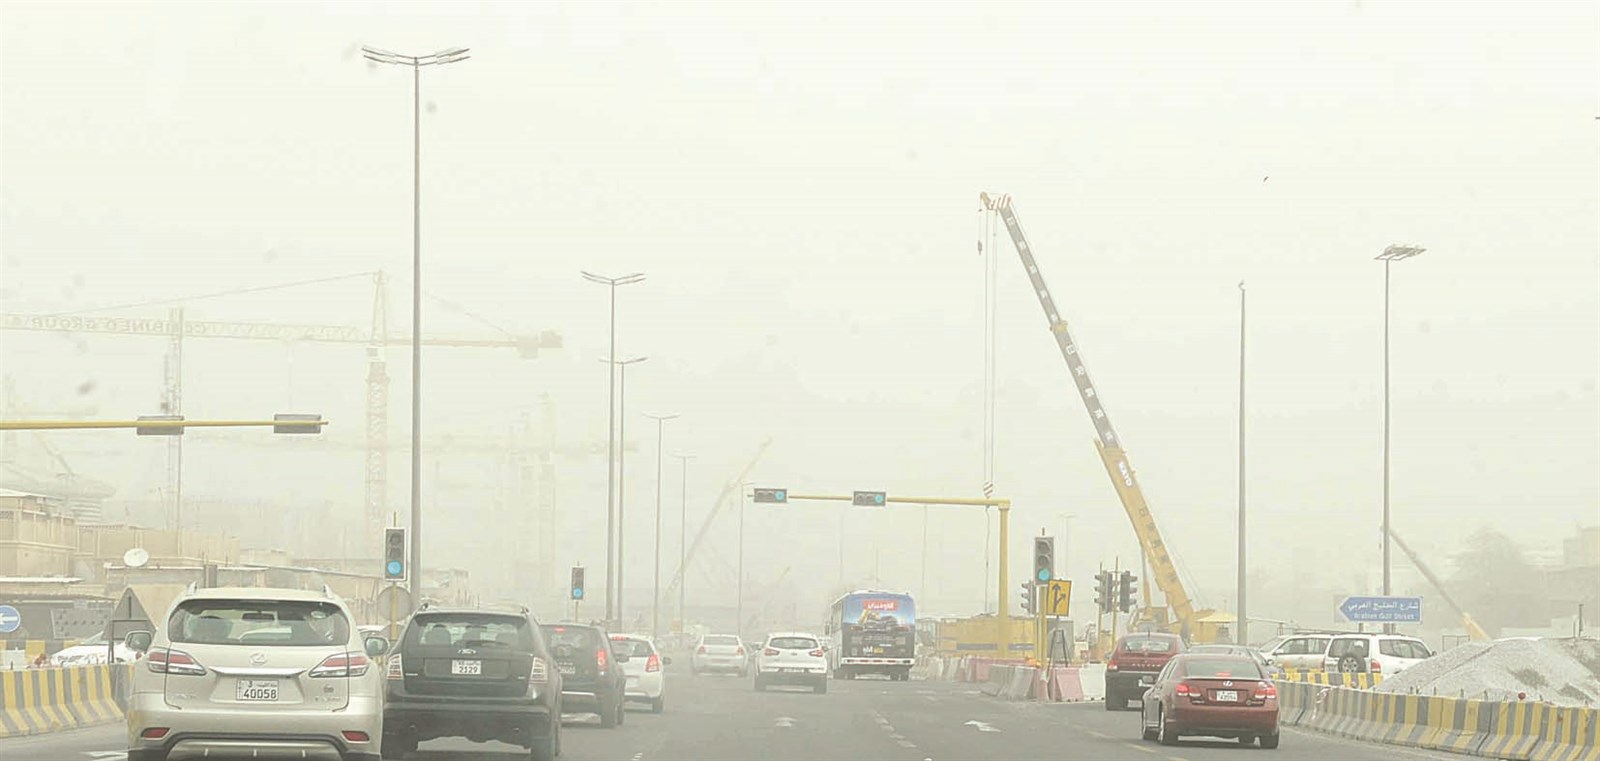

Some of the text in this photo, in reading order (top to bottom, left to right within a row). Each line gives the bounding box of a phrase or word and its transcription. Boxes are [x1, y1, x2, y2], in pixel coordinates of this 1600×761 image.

[1347, 601, 1419, 611] شارع الخليج العربي
[1353, 612, 1414, 620] Arabian Gulf Street
[243, 688, 277, 699] 40058
